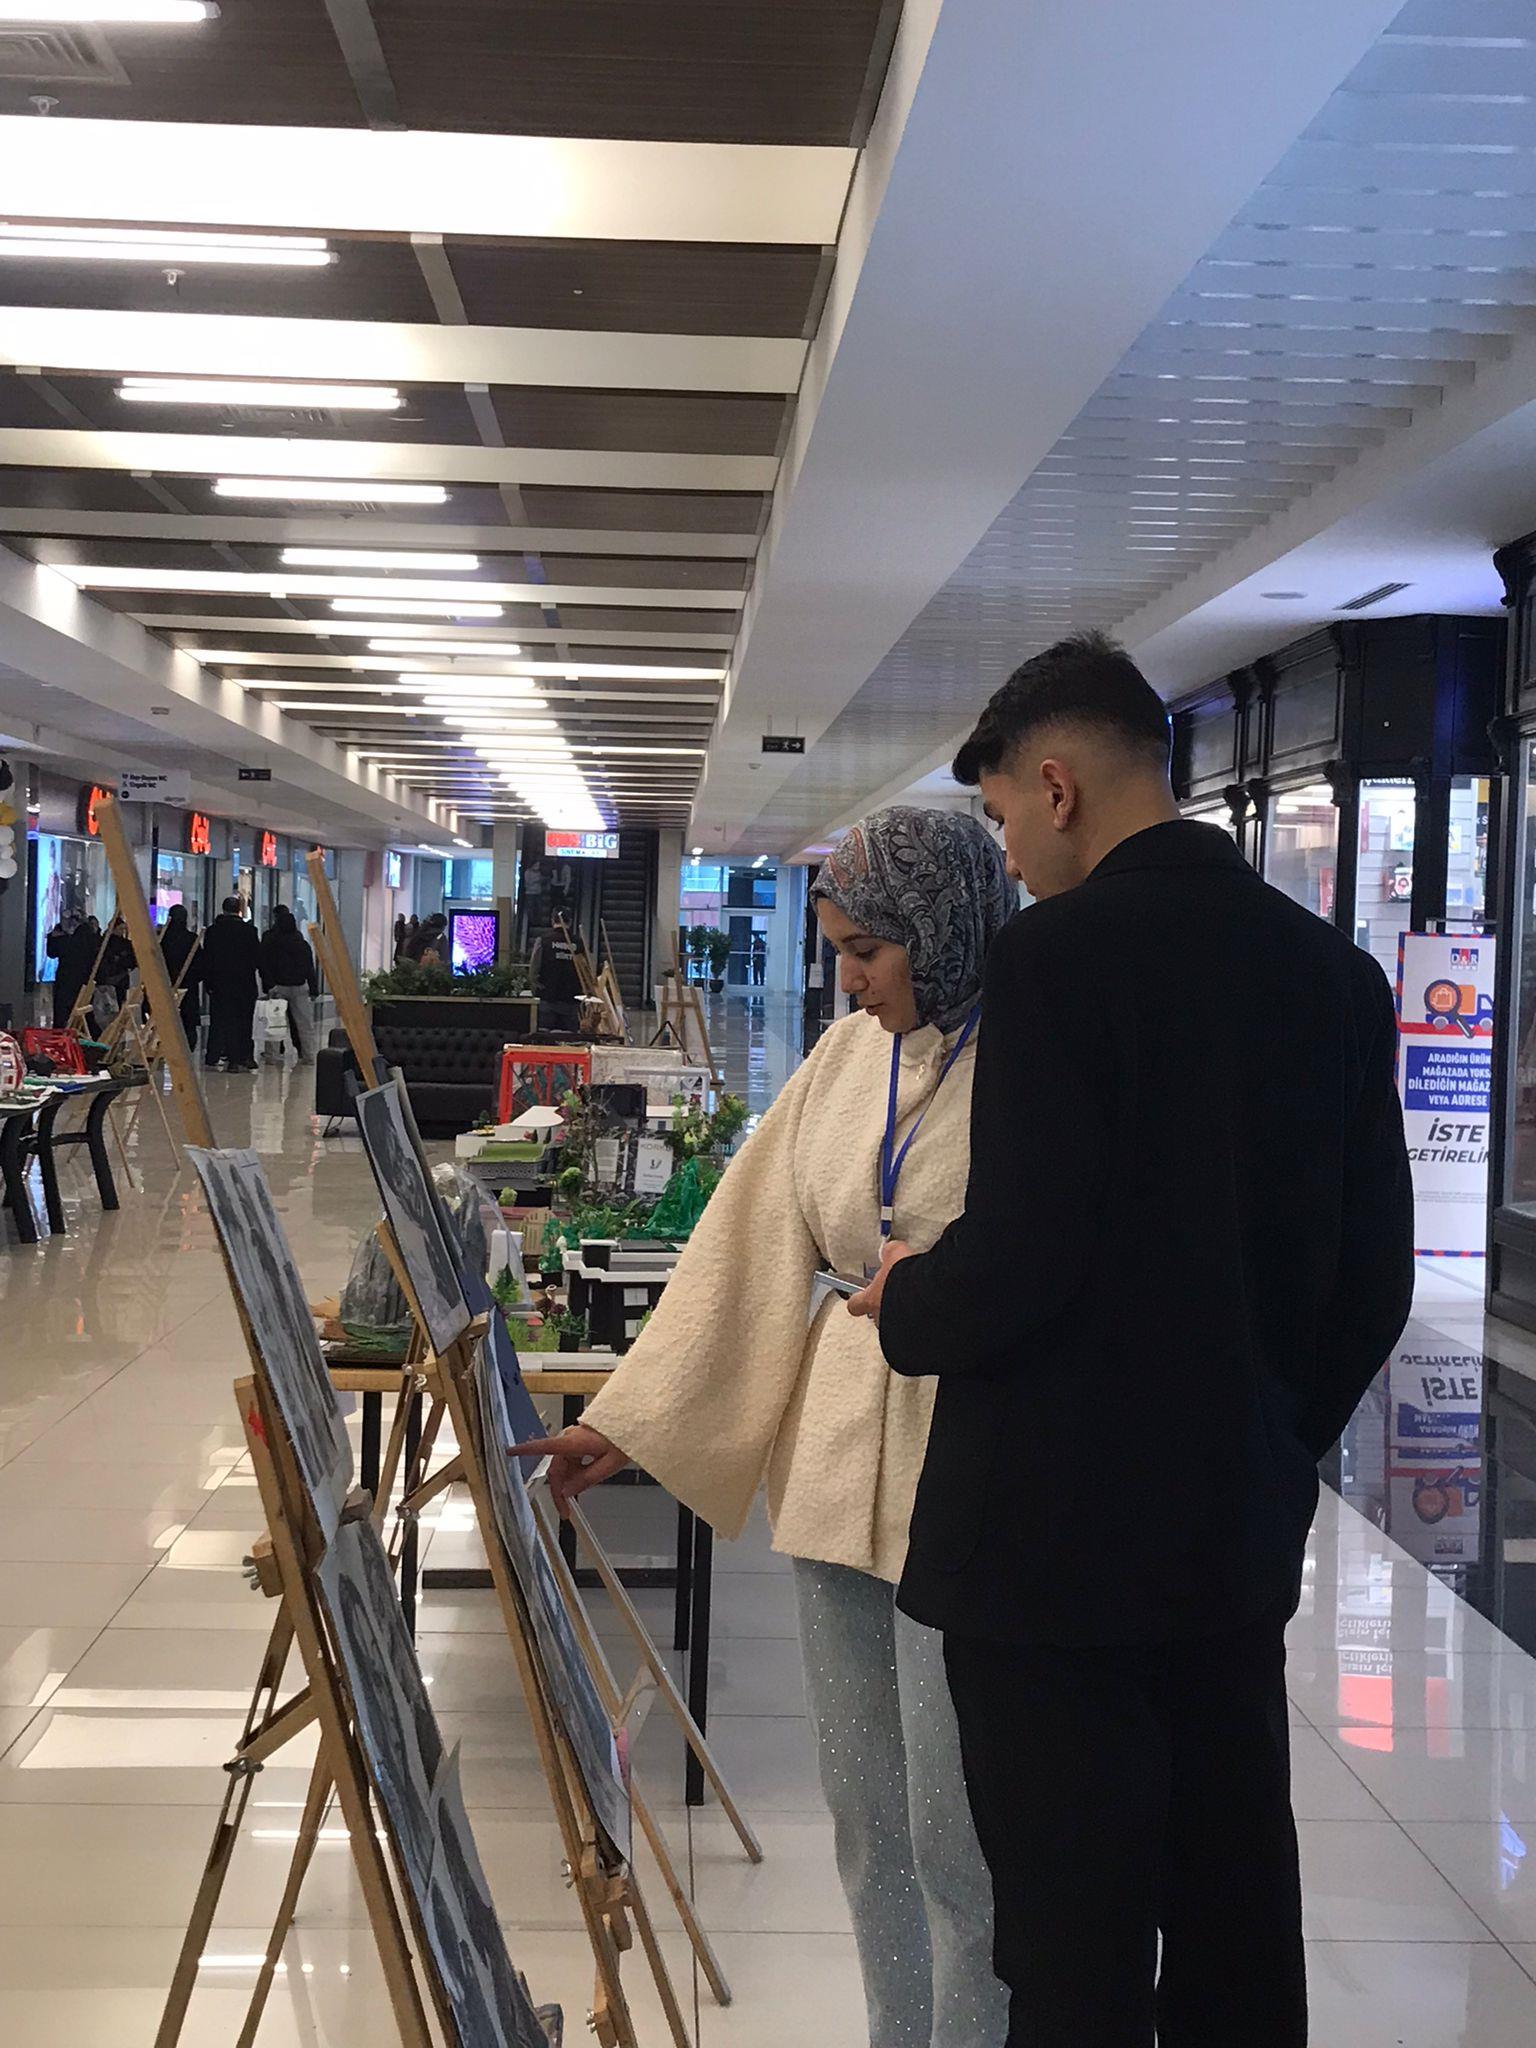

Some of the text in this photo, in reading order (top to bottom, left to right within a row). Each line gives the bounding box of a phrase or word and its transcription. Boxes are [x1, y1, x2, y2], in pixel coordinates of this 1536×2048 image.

[1428, 1052, 1468, 1064] ARADIĞIN
[1422, 1065, 1491, 1078] MAĞAZADA YOKS
[1408, 1077, 1457, 1091] DİLEDİĞİN
[1428, 1094, 1487, 1106] VEYA ADRESE
[1427, 1117, 1485, 1143] İSTE
